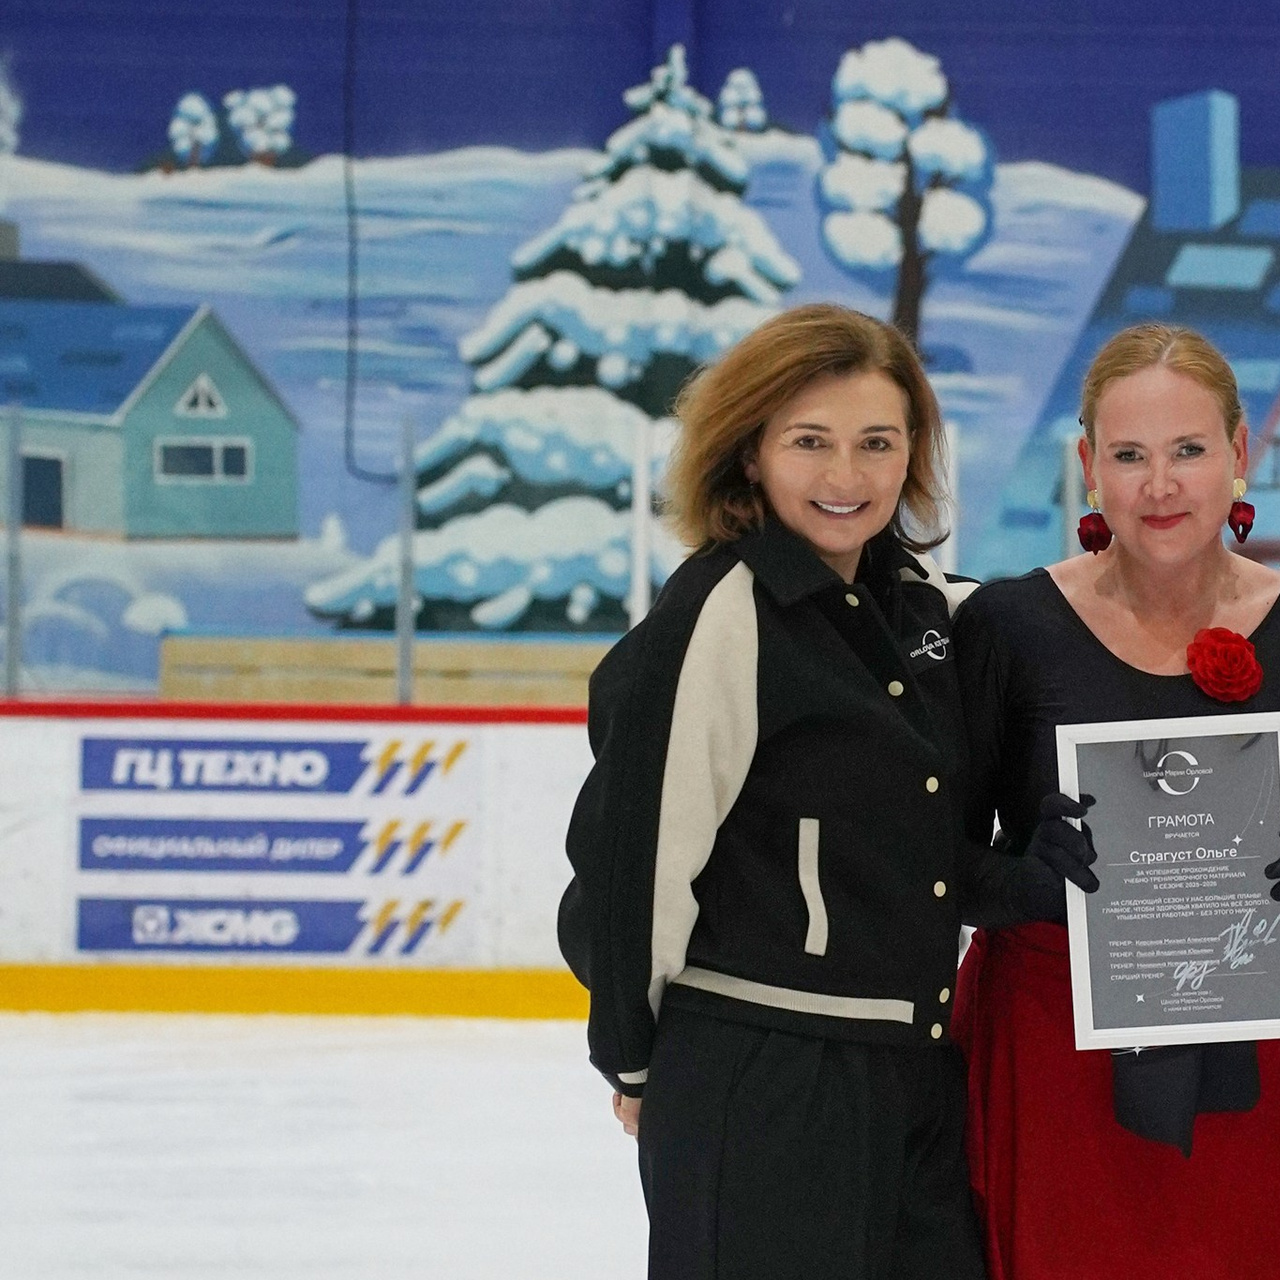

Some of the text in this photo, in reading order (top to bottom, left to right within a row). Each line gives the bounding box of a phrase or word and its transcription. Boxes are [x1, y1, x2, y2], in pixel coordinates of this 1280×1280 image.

[112, 748, 330, 789] ГЦ ТЕХНО
[1143, 767, 1213, 778] Школа Марии Орловой
[1148, 813, 1214, 828] ГРАМОТА
[1130, 845, 1237, 865] Страгуст Ольге
[1145, 868, 1180, 876] УСПЕШНОЕ
[1181, 865, 1229, 874] ПРОХОЖДЕНИЕ
[1150, 874, 1208, 883] ТРЕНИРОВОЧНОГО
[1121, 898, 1162, 906] СЛЕДУЮЩИЙ
[1156, 903, 1190, 912] ЗДОРОВЬЯ
[1111, 973, 1140, 981] СТАРШИЙ
[1200, 995, 1224, 1003] Орловой
